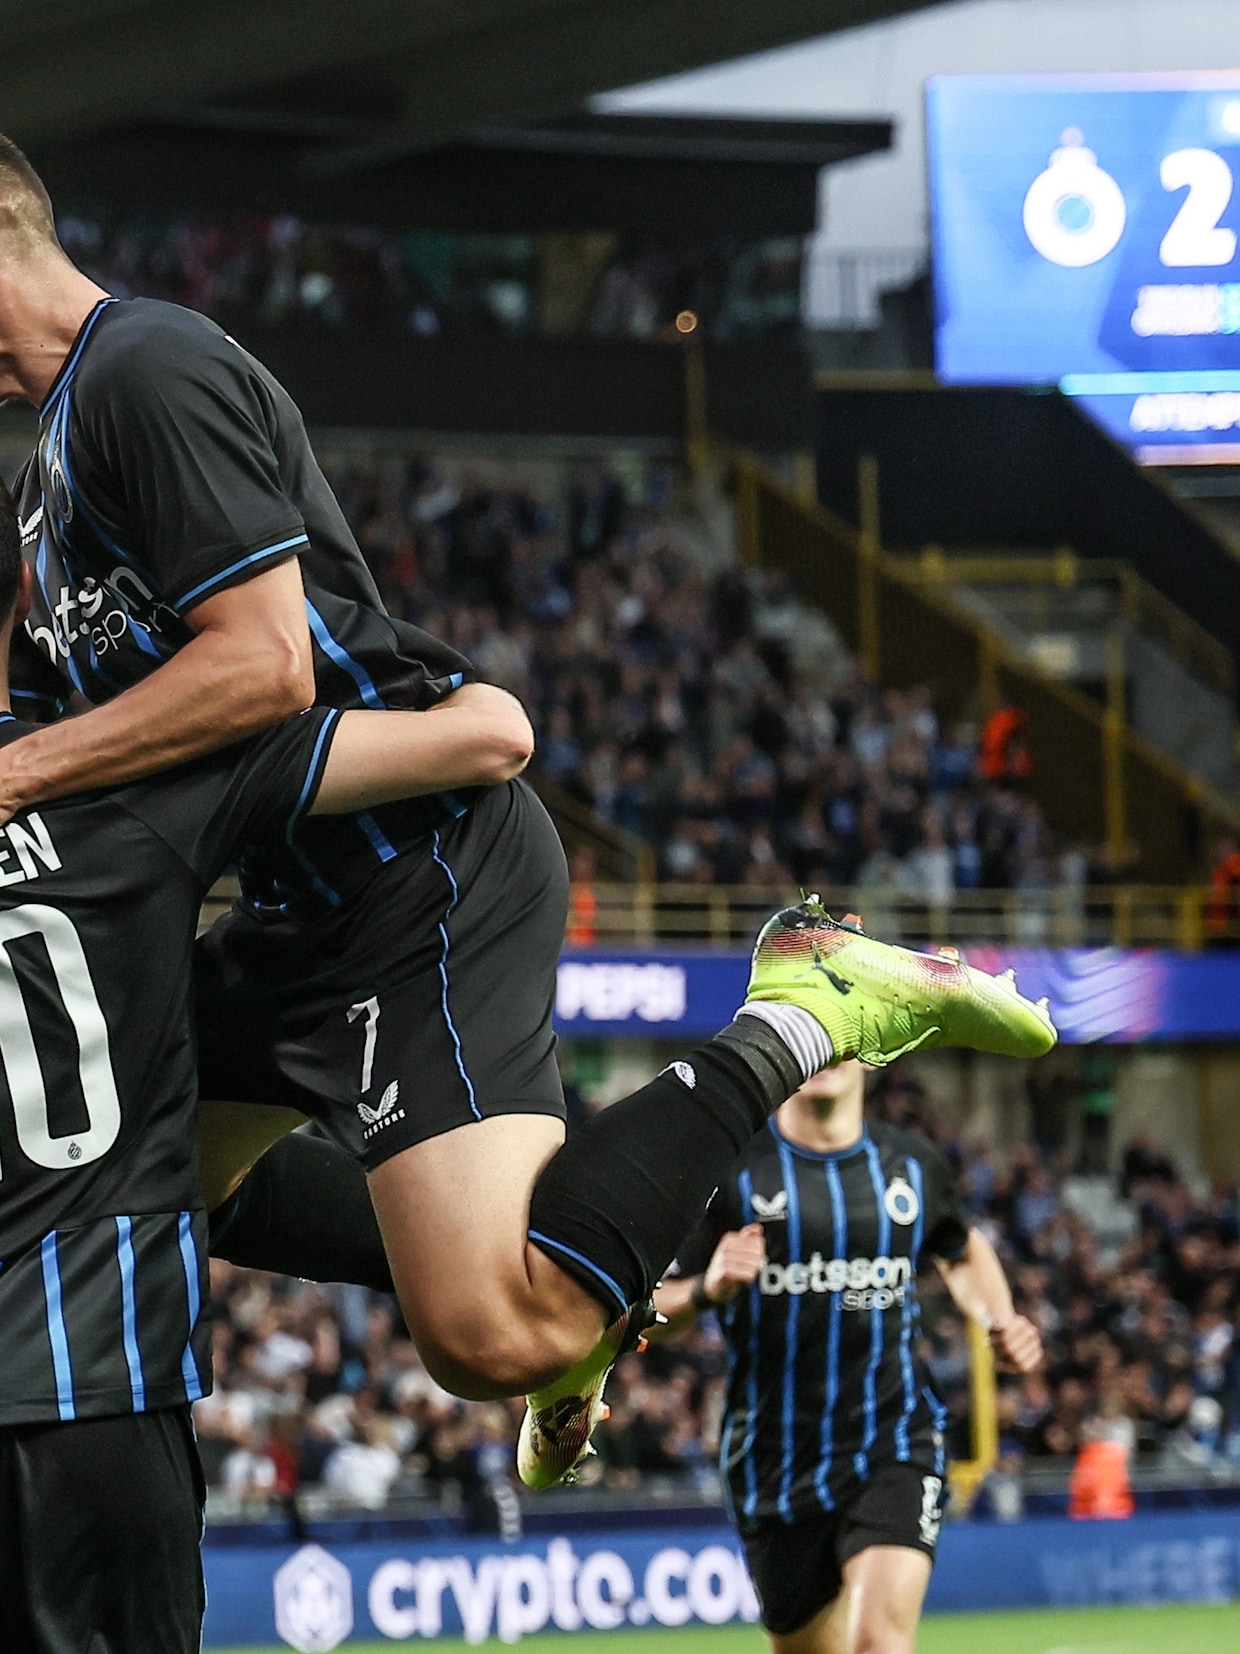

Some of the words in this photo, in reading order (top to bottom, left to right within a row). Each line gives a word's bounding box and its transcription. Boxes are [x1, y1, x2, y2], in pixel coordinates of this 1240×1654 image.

[1159, 148, 1237, 267] 2
[345, 996, 381, 1093] 7
[368, 1536, 762, 1646] crypto.co
